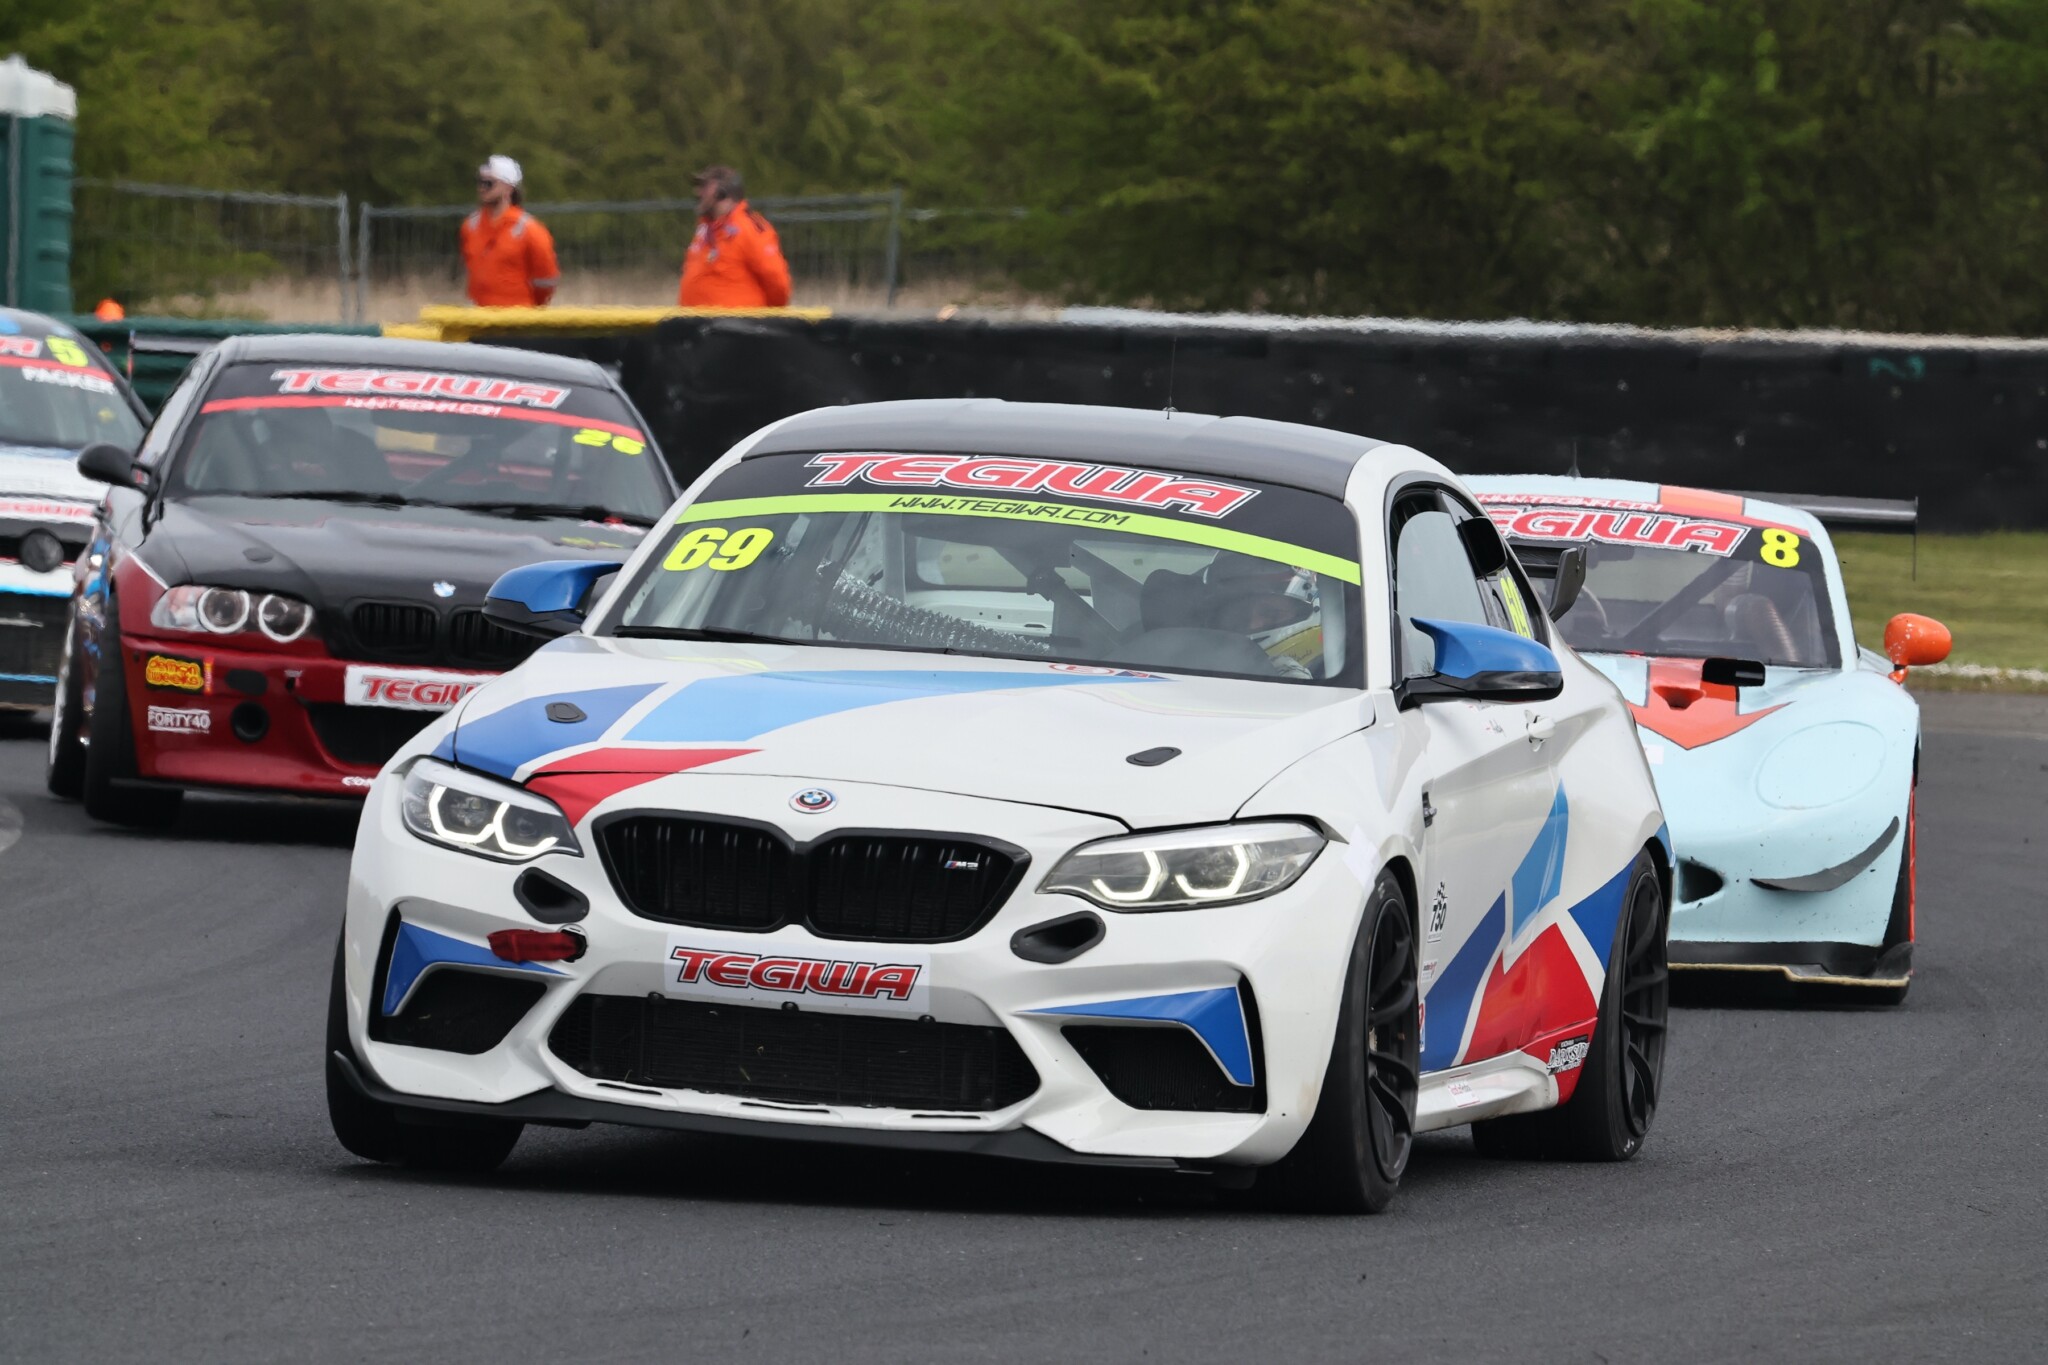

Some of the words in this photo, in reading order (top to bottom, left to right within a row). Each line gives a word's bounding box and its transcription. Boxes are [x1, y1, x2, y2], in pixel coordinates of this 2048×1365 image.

[270, 367, 572, 409] TEGIWA
[803, 450, 1262, 520] TEGIWA
[888, 496, 1131, 527] WWW.TEGIWA.COM
[1484, 504, 1752, 558] EGIWA
[662, 527, 774, 571] 69
[1760, 527, 1800, 568] 8
[148, 711, 211, 729] FORTY40
[670, 945, 922, 1001] TEGIWA
